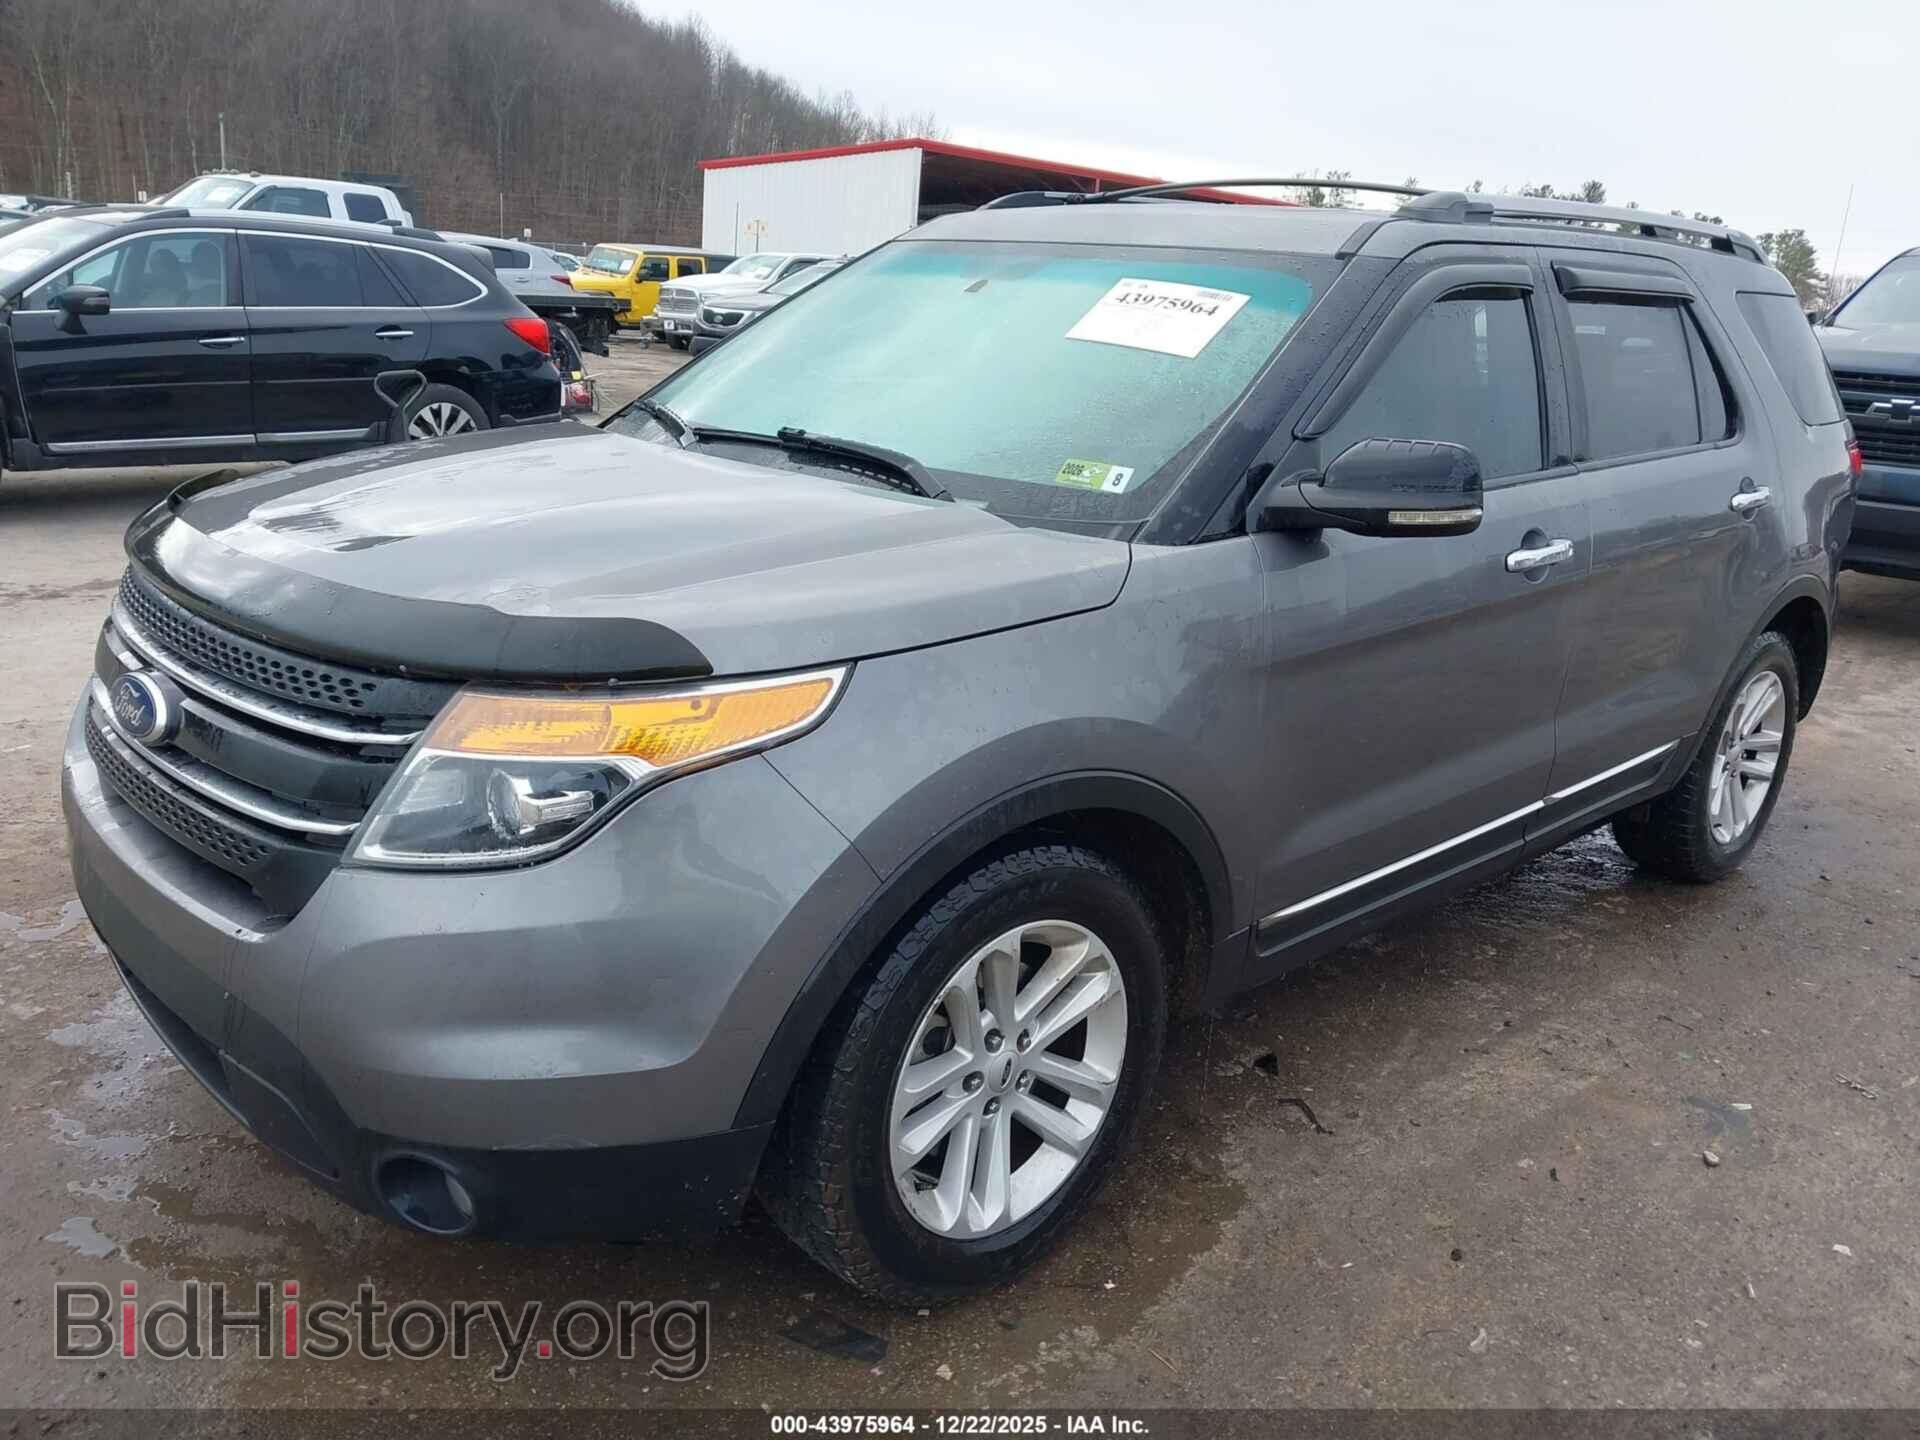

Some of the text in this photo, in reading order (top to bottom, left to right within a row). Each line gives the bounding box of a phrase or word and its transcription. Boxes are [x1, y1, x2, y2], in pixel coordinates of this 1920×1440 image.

[1115, 291, 1220, 317] 43975964
[1111, 472, 1124, 487] 8
[114, 681, 146, 727] Ford
